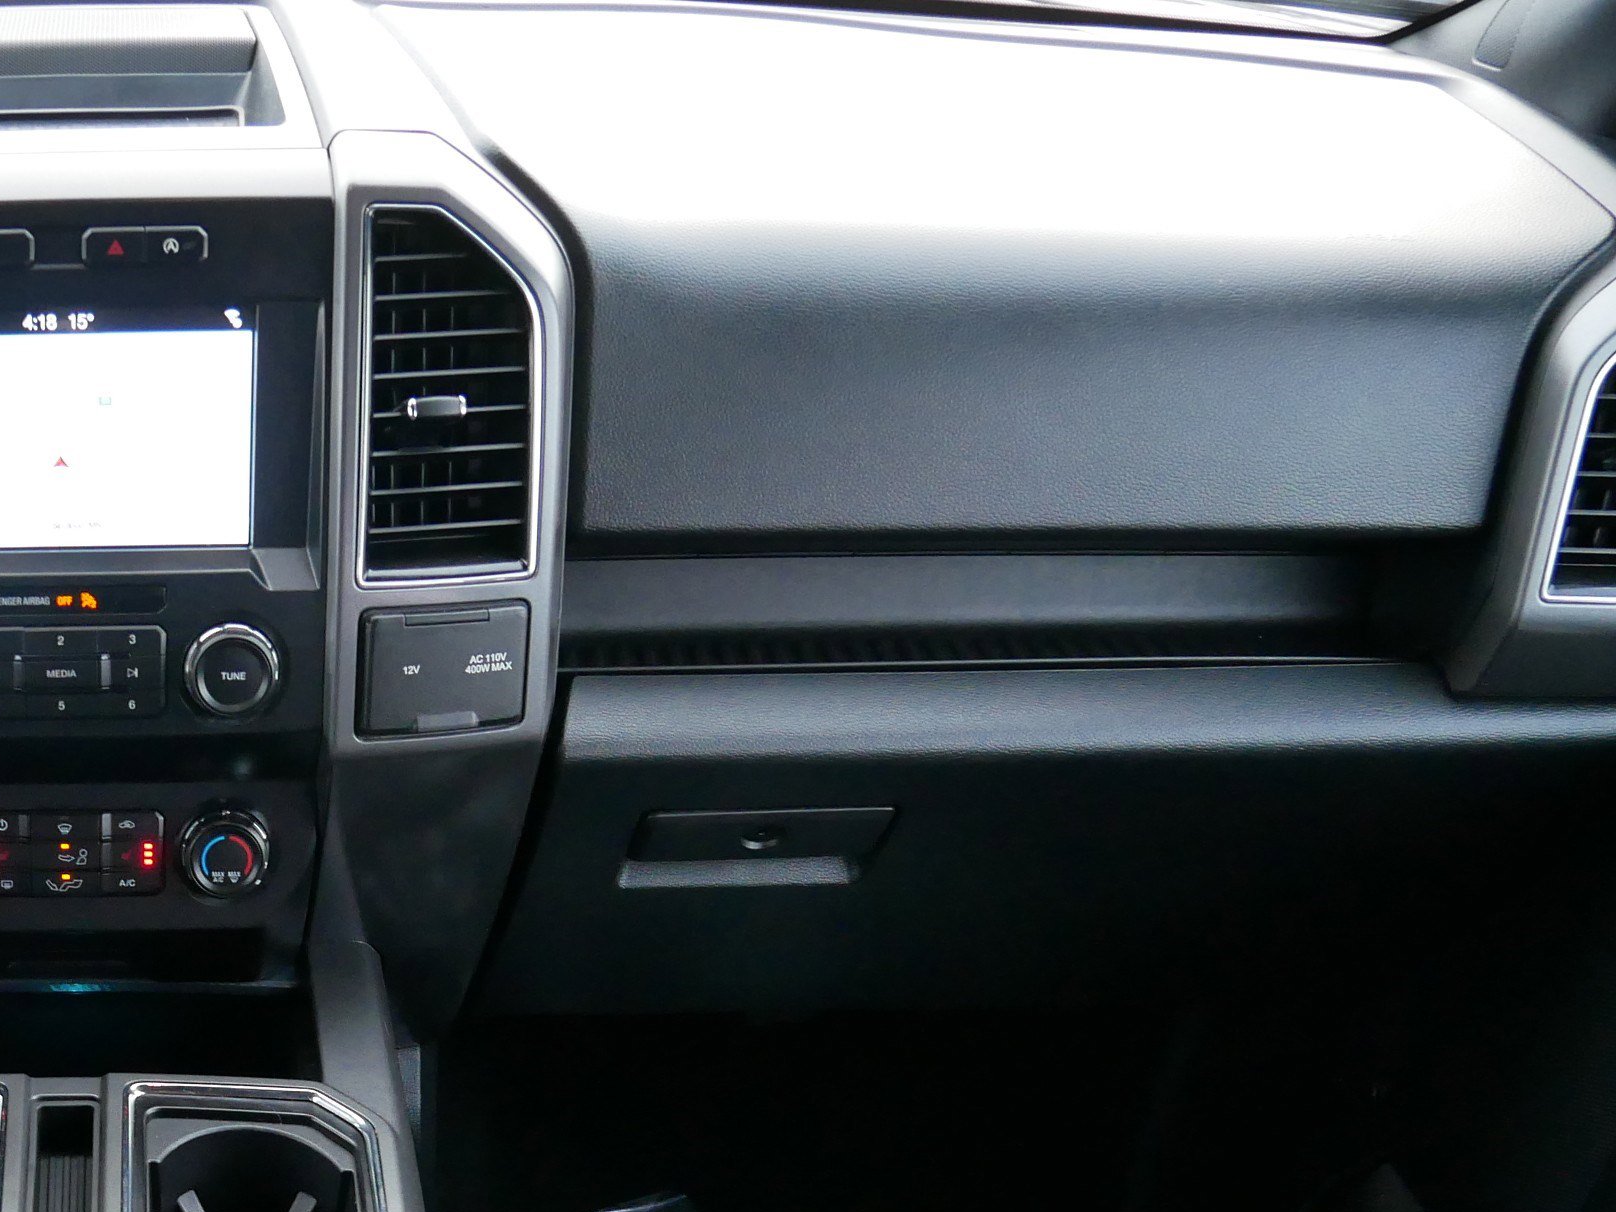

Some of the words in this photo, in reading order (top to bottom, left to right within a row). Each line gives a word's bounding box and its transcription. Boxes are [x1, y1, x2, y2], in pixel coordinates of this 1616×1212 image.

[22, 314, 57, 331] 4:18
[23, 596, 51, 606] AIRBAG
[56, 595, 74, 607] OFF
[57, 636, 64, 646] 2
[129, 635, 136, 645] 3
[469, 654, 484, 664] AC
[485, 652, 507, 663] 110V
[402, 664, 421, 675] 12V
[465, 663, 491, 674] 400W
[491, 661, 513, 672] MAX
[46, 669, 77, 679] MEDIA
[221, 671, 247, 681] TUNE
[58, 701, 65, 711] 5
[129, 700, 136, 710] 6
[119, 879, 136, 888] A/C
